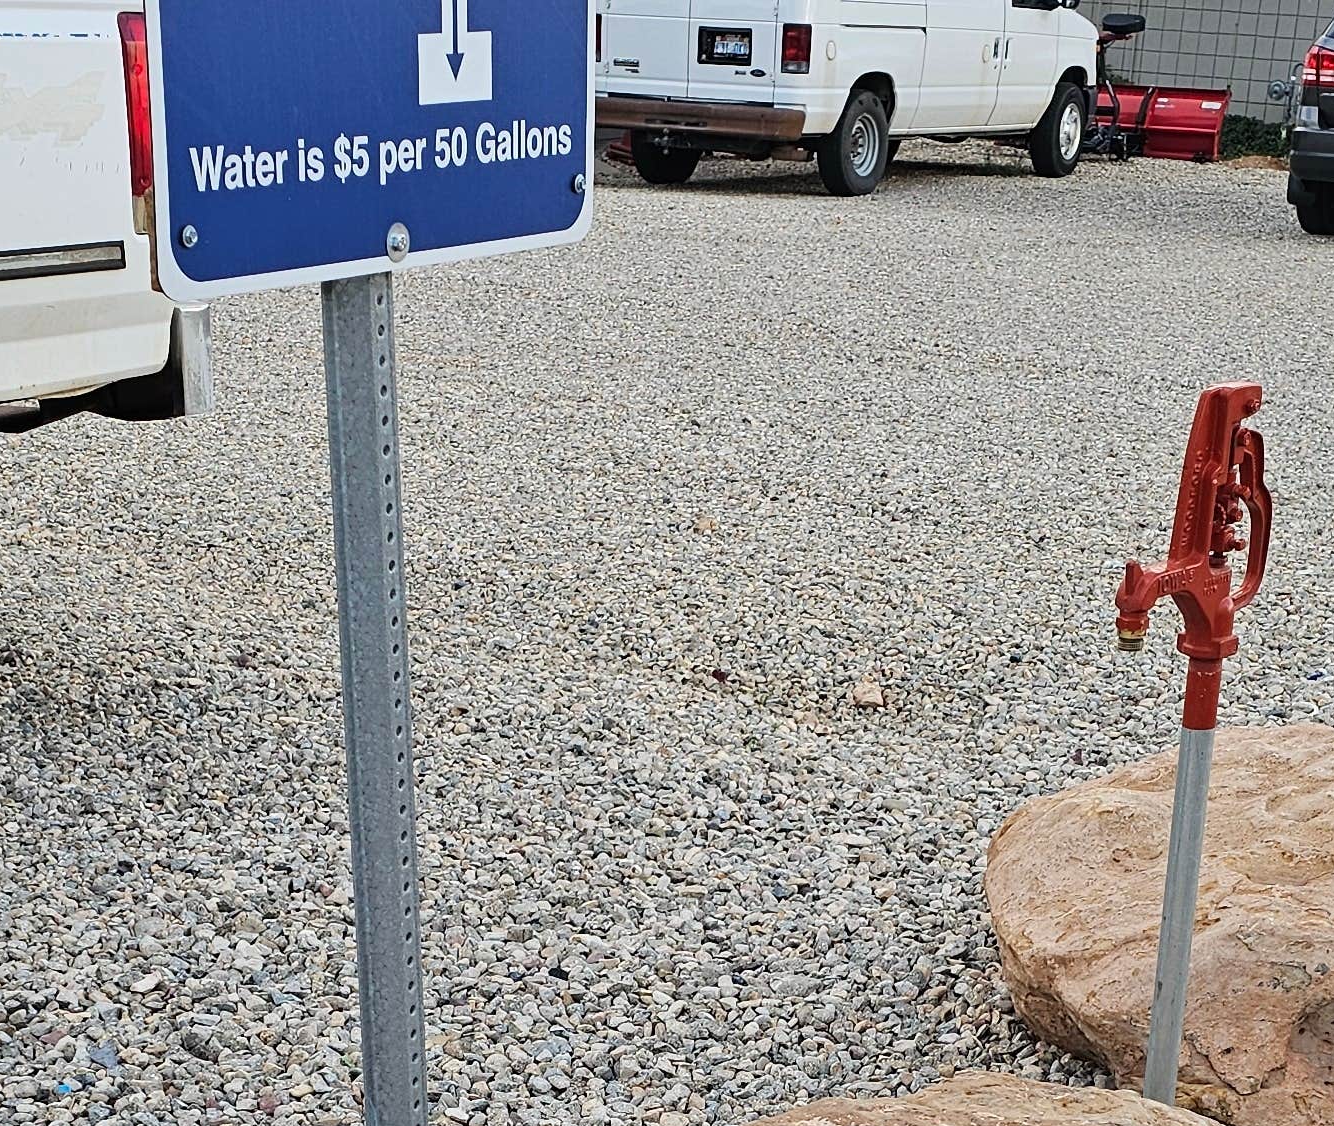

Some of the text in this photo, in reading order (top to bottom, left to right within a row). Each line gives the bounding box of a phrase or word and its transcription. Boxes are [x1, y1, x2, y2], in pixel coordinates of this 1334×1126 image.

[189, 119, 572, 192] Water is $5 per 50 Gallons
